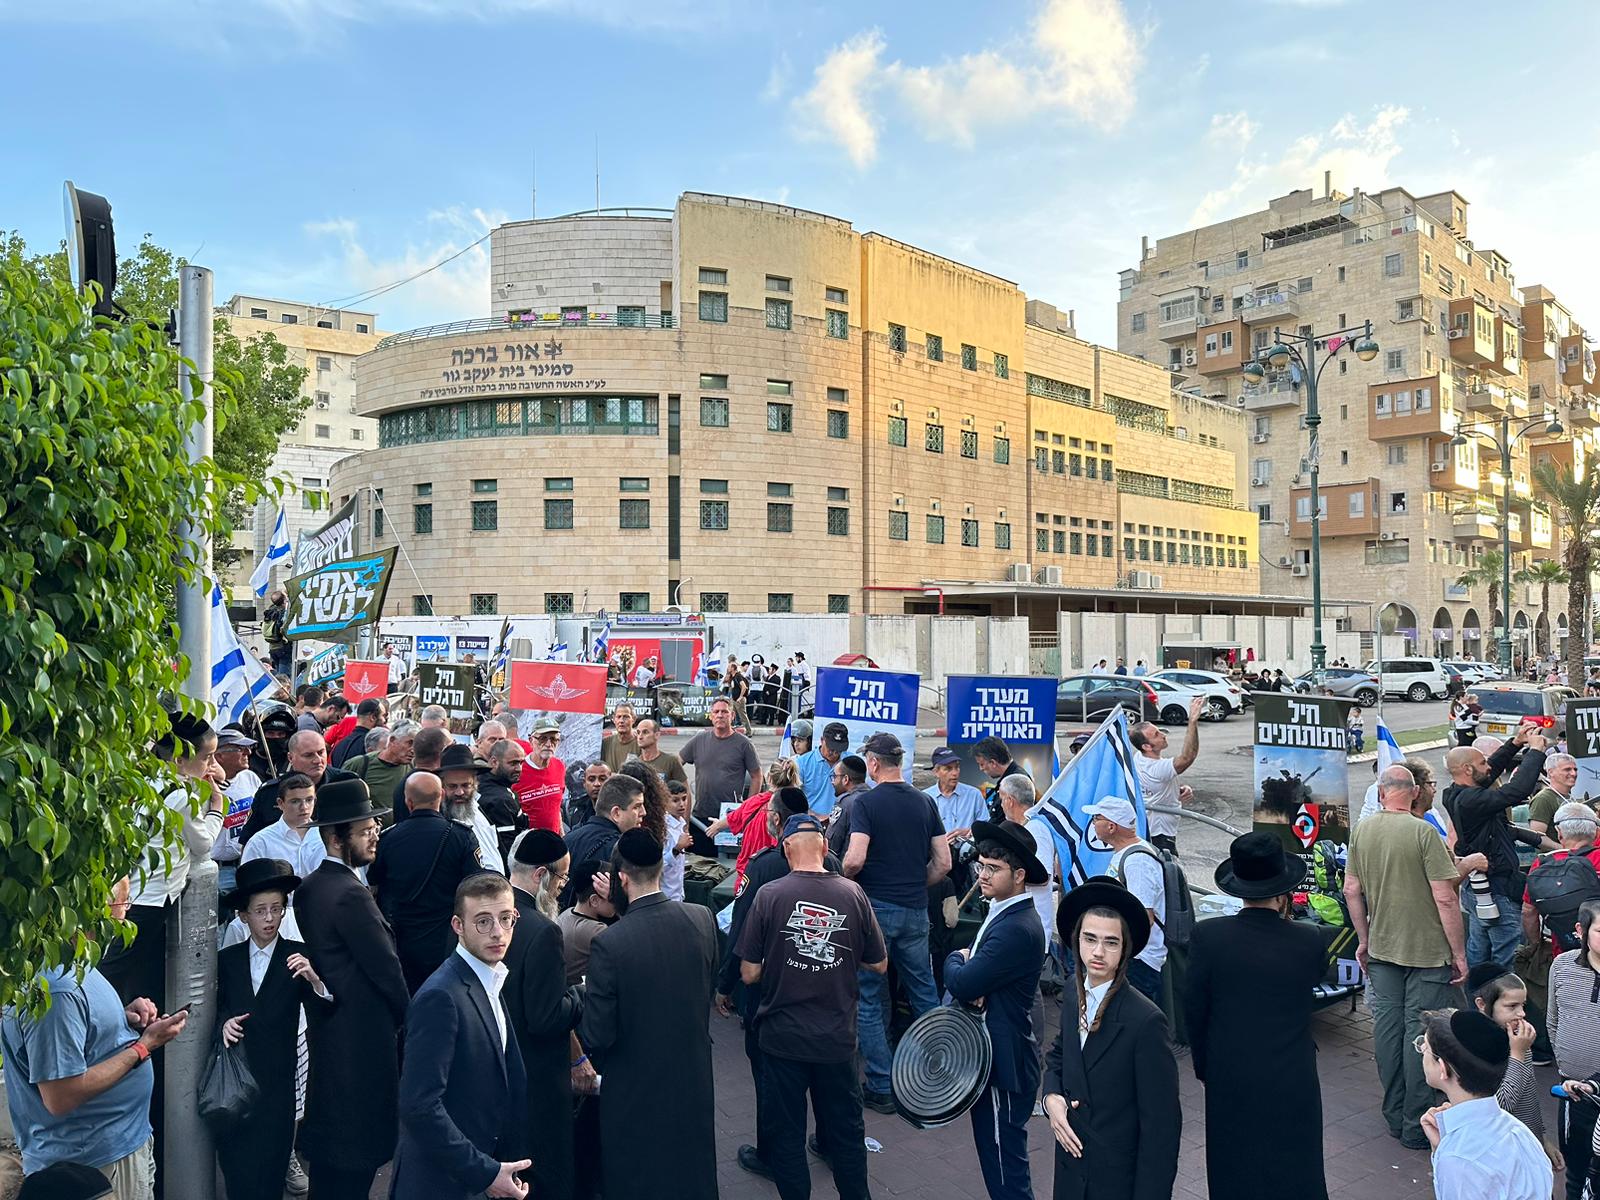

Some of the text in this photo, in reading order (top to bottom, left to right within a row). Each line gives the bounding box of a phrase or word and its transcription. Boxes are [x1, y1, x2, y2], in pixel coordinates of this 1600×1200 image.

[451, 342, 540, 366] אור ברכה
[463, 366, 496, 383] יעקב
[499, 364, 526, 378] בית
[529, 363, 574, 377] סמינר
[475, 384, 497, 392] ברכה
[498, 382, 517, 391] מרת
[518, 381, 555, 391] החשובה
[556, 380, 584, 389] האשה
[418, 640, 448, 650] שלדג
[435, 667, 455, 687] חיל
[422, 686, 465, 707] הרגלים
[848, 677, 885, 699] חיל
[975, 687, 1029, 706] מערך
[832, 697, 899, 721] האוויר
[970, 705, 1034, 724] ההגנה
[1287, 699, 1320, 725] חיל
[961, 721, 1042, 740] האווירית
[1257, 721, 1346, 749] התותחנים
